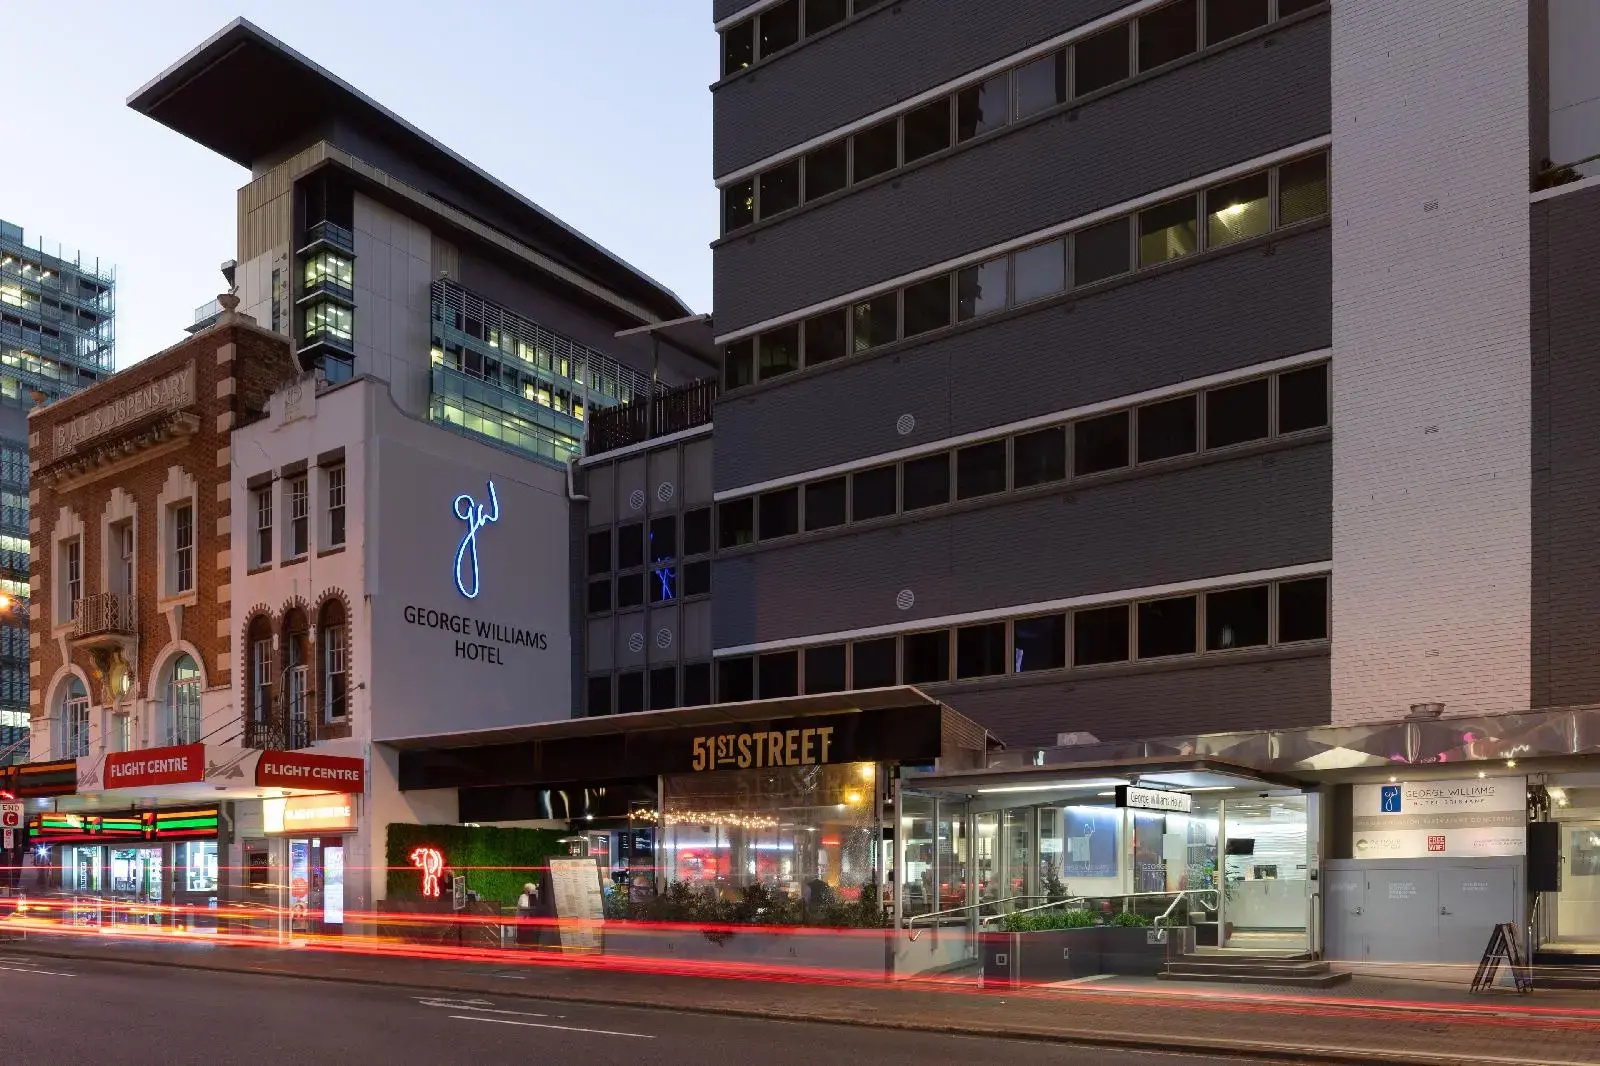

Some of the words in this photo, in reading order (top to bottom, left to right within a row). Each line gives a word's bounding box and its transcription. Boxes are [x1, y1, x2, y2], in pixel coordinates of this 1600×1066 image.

[107, 370, 189, 426] DISPENSARY
[404, 605, 471, 635] GEORGE
[475, 619, 548, 650] WILLIAMS
[455, 639, 504, 665] HOTEL
[737, 726, 834, 769] STREET
[111, 761, 146, 778] FLIGHT
[147, 757, 188, 773] CENTRE
[264, 763, 310, 777] FLIGHT
[312, 767, 359, 780] CENTRE
[1405, 788, 1445, 799] GEORGE
[1447, 785, 1496, 797] WILLIAMS
